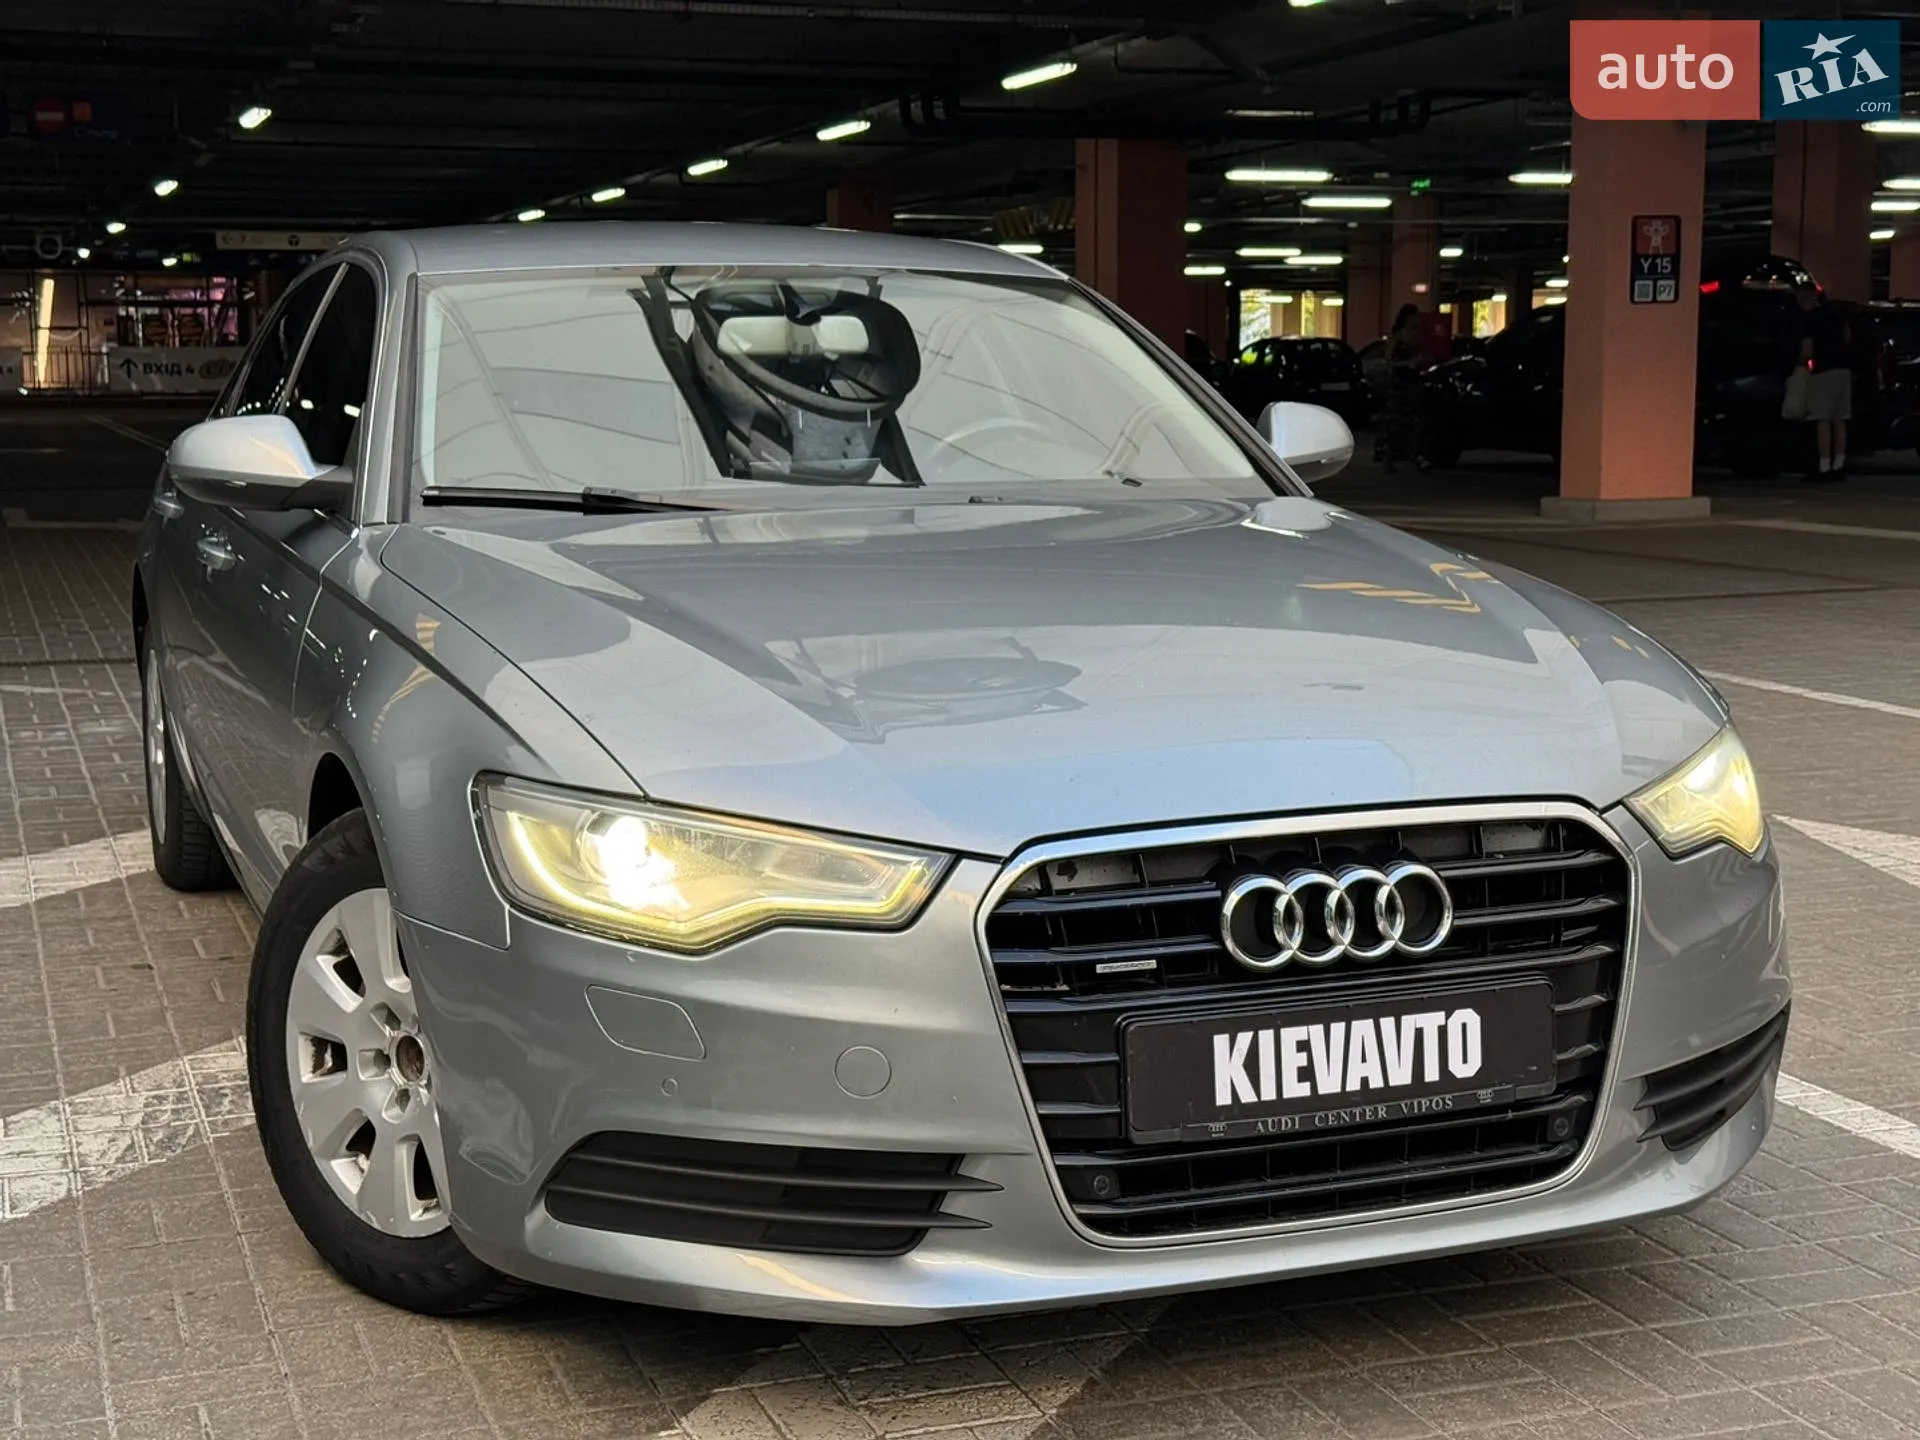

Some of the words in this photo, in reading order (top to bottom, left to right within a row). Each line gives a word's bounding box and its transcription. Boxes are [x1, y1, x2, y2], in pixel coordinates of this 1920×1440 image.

[1213, 1007, 1483, 1106] KIEVAVTO
[1255, 1117, 1300, 1134] AUDI
[1314, 1105, 1388, 1128] CENTER
[1400, 1096, 1454, 1116] VIPOS
